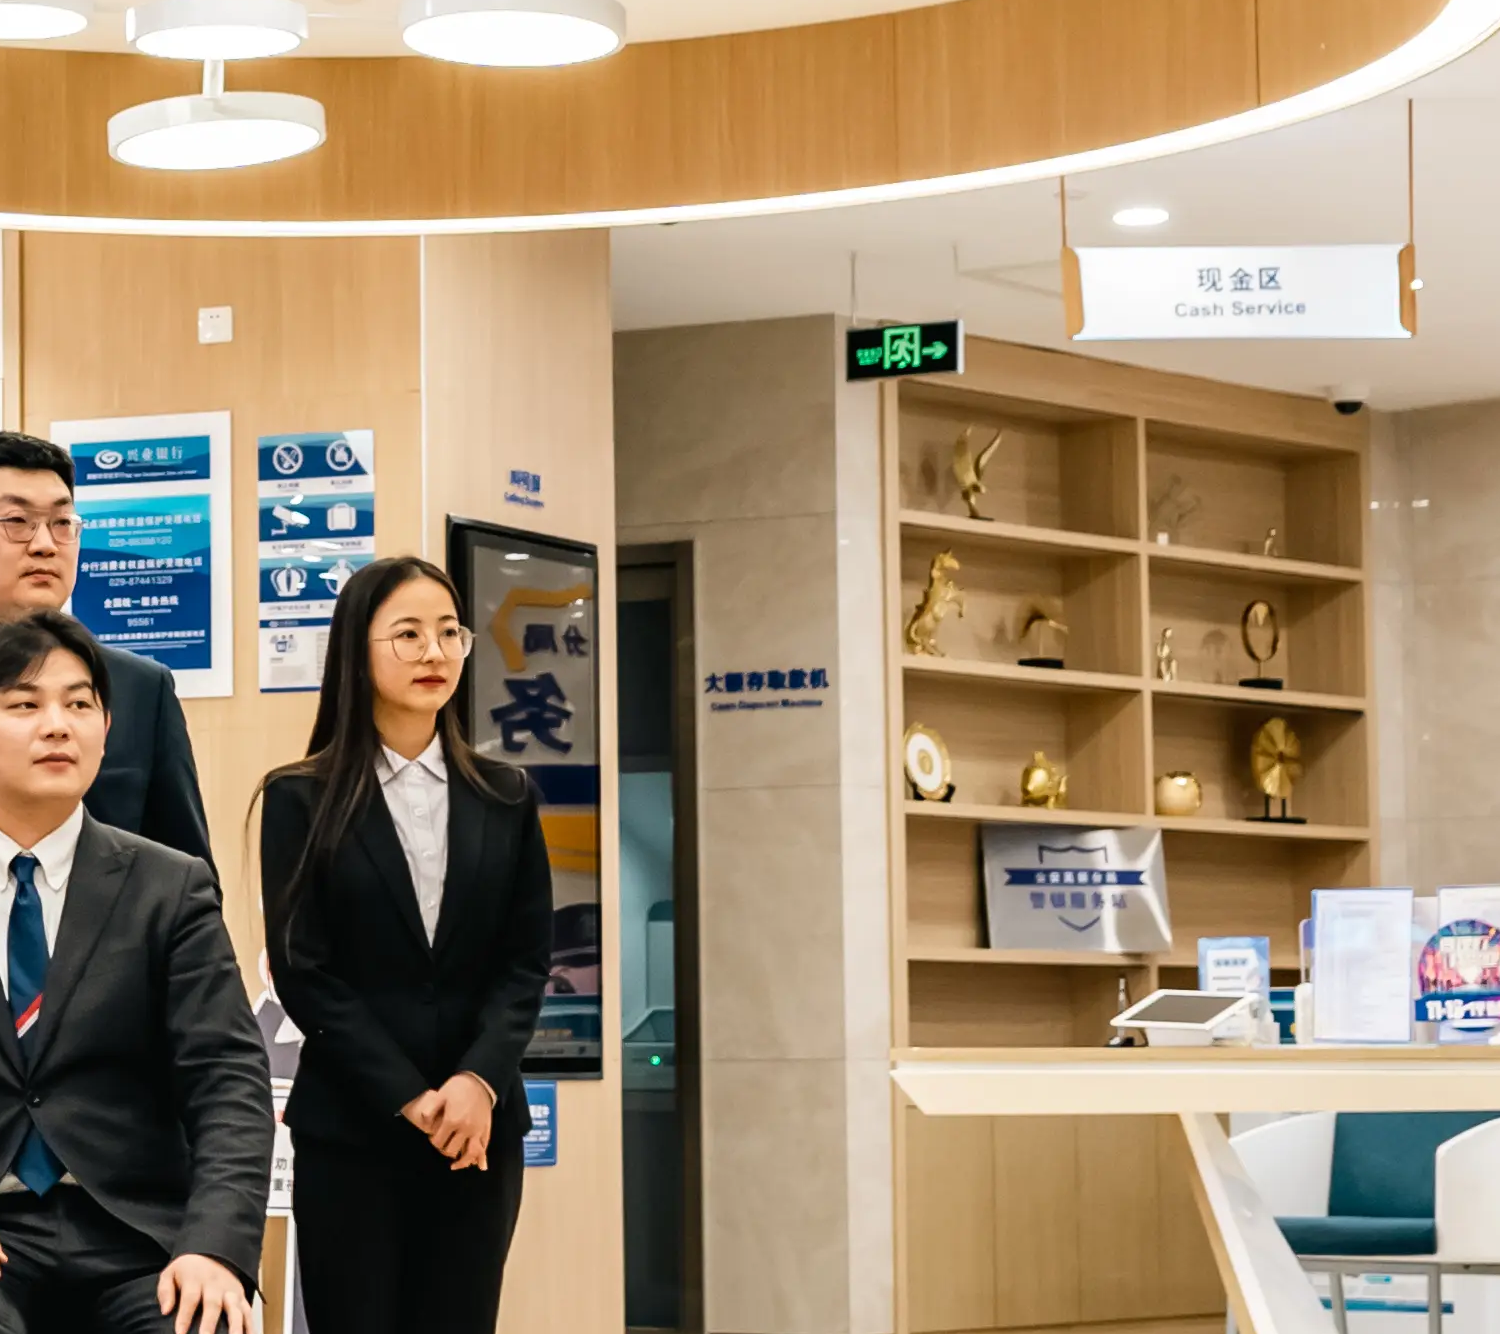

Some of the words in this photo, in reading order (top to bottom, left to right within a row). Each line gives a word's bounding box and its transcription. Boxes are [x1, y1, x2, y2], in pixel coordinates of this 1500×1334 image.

[1196, 267, 1282, 292] 现金区
[1174, 302, 1224, 317] Cash
[1231, 300, 1306, 316] Service
